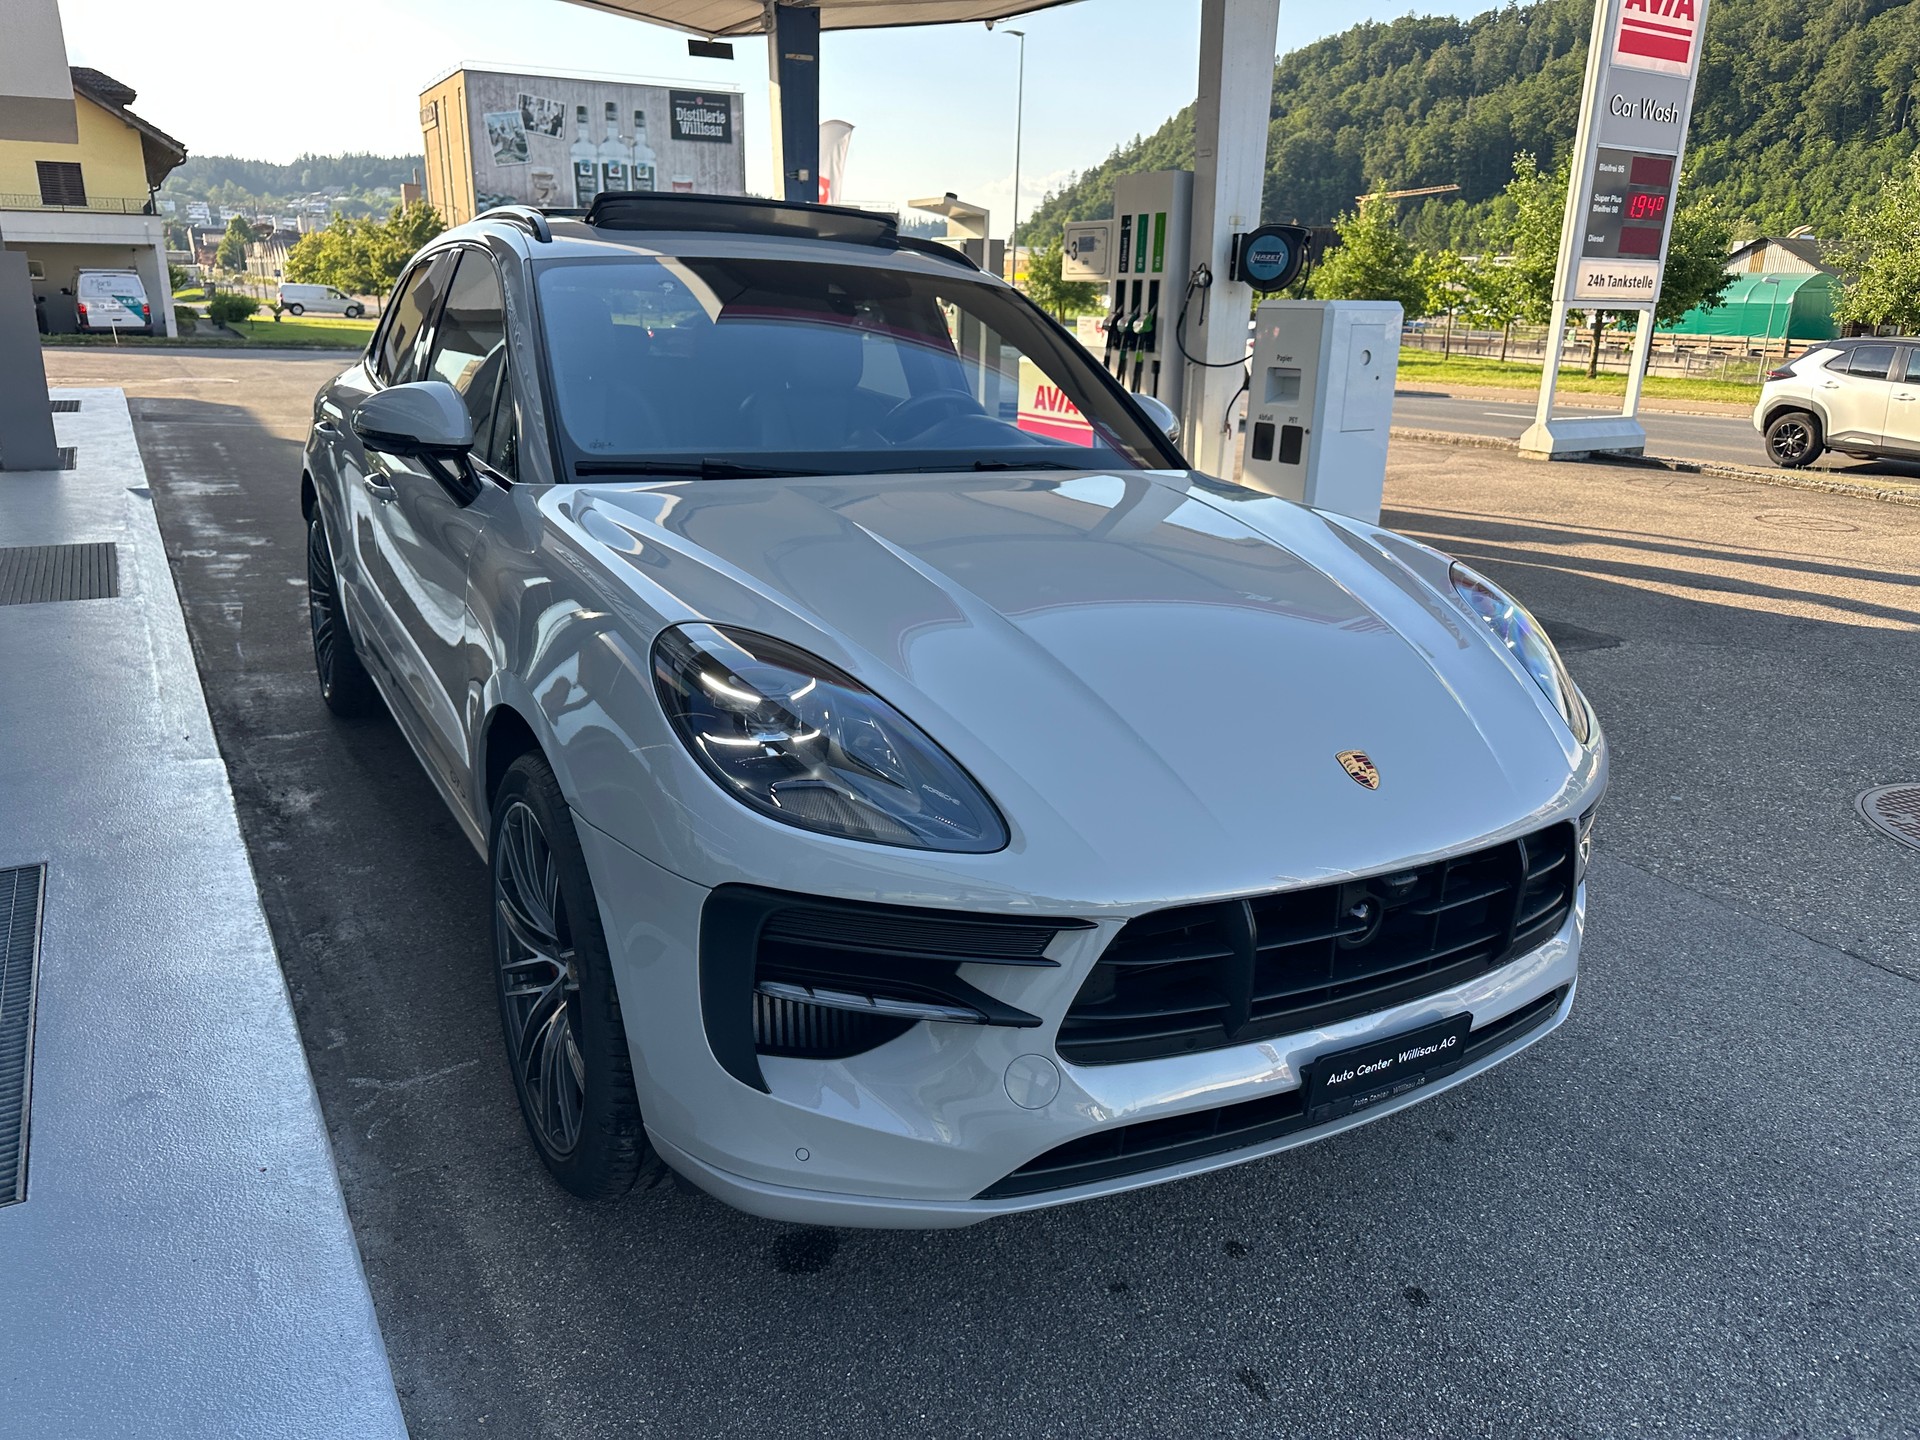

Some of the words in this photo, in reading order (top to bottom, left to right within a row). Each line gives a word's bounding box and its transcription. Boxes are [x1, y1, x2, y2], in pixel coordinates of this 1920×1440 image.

[675, 107, 726, 124] Distillerie
[1610, 94, 1638, 117] Car
[1641, 97, 1679, 123] Wash
[679, 121, 723, 137] Willisau
[1599, 163, 1618, 173] Bleifrei
[1618, 165, 1625, 173] 95
[1594, 194, 1610, 203] Super
[1610, 194, 1622, 203] Plus
[1592, 204, 1611, 213] Bleifrei
[1588, 234, 1605, 243] Diesel
[1071, 241, 1078, 261] 3
[1587, 274, 1605, 287] 24h
[1607, 275, 1653, 288] Tankstelle
[1277, 354, 1293, 363] Papier
[1259, 413, 1274, 421] Abfall
[1288, 416, 1299, 424] PET
[922, 784, 960, 806] PORSCHE
[1326, 1069, 1354, 1086] Auto
[1357, 1058, 1393, 1076] Center
[1398, 1043, 1438, 1063] Willisau
[1439, 1035, 1457, 1050] AG
[1353, 1097, 1368, 1108] Auto
[1369, 1090, 1390, 1102] Center
[1392, 1082, 1416, 1094] Willisau
[1415, 1077, 1426, 1087] AG
